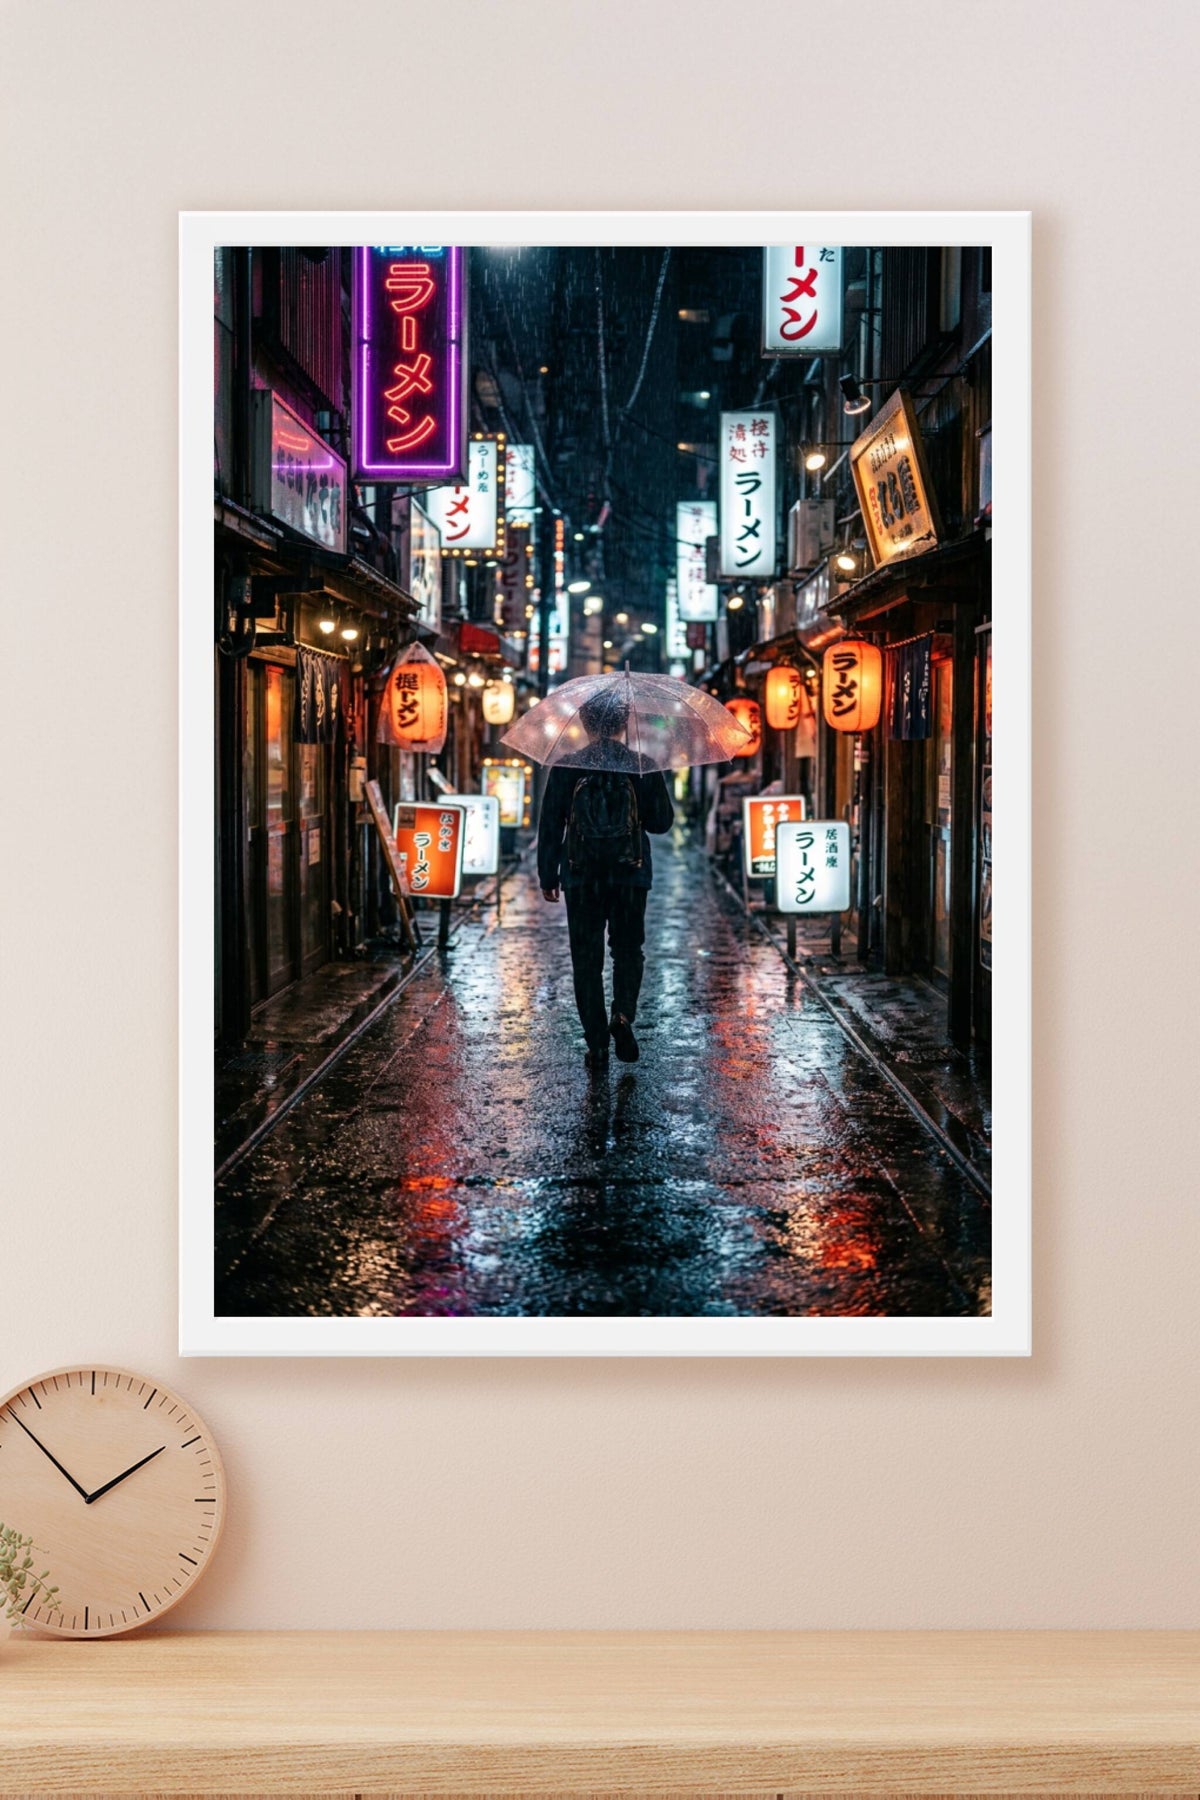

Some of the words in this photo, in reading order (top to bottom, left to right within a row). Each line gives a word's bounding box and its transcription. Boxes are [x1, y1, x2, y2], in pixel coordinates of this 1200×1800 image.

[384, 263, 435, 452] ラーメン
[735, 471, 762, 568] ラーメン
[832, 652, 857, 716] ラーメン
[412, 832, 431, 889] ラーメン
[795, 832, 816, 904] ラーメン
